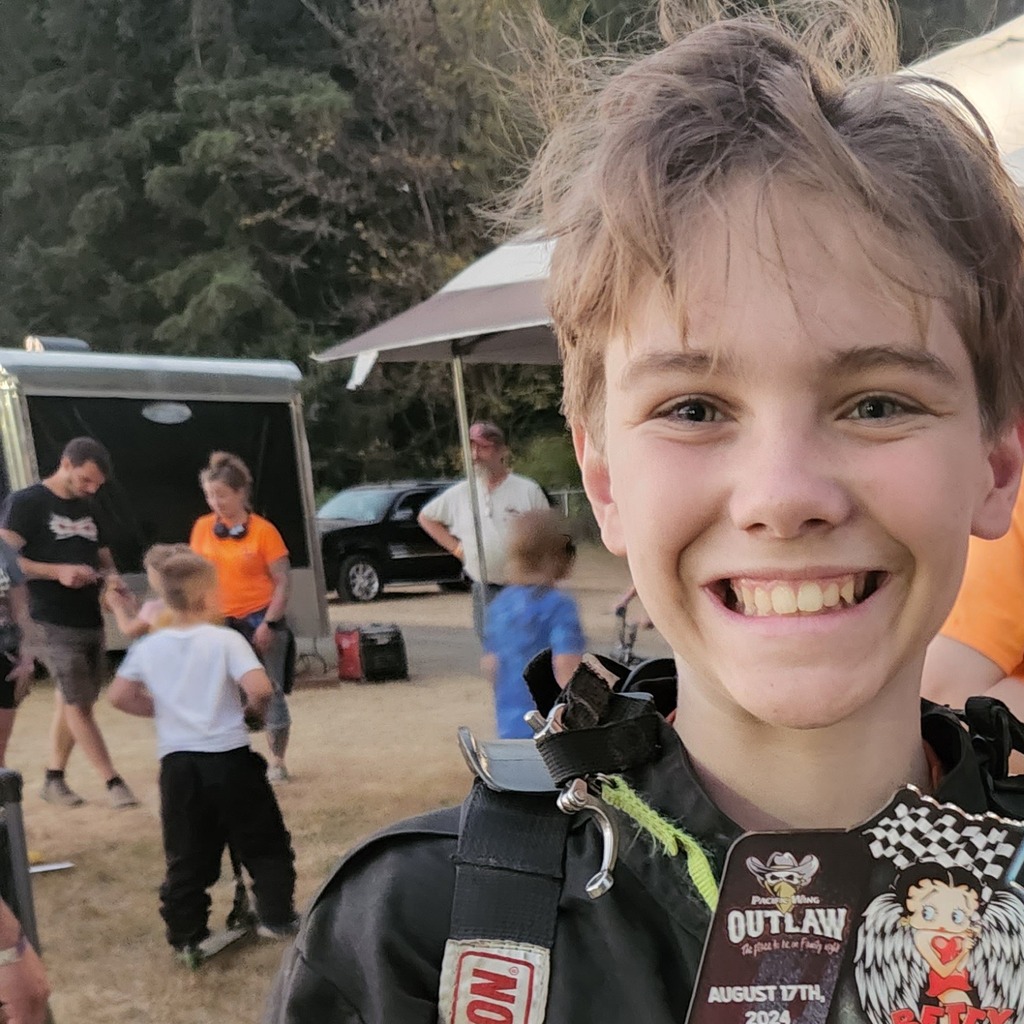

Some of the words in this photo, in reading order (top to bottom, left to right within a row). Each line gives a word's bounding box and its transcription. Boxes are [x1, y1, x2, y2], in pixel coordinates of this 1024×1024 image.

[727, 908, 847, 944] OUTLAW
[708, 985, 778, 1003] AUGUST
[779, 984, 826, 1003] 17TH,
